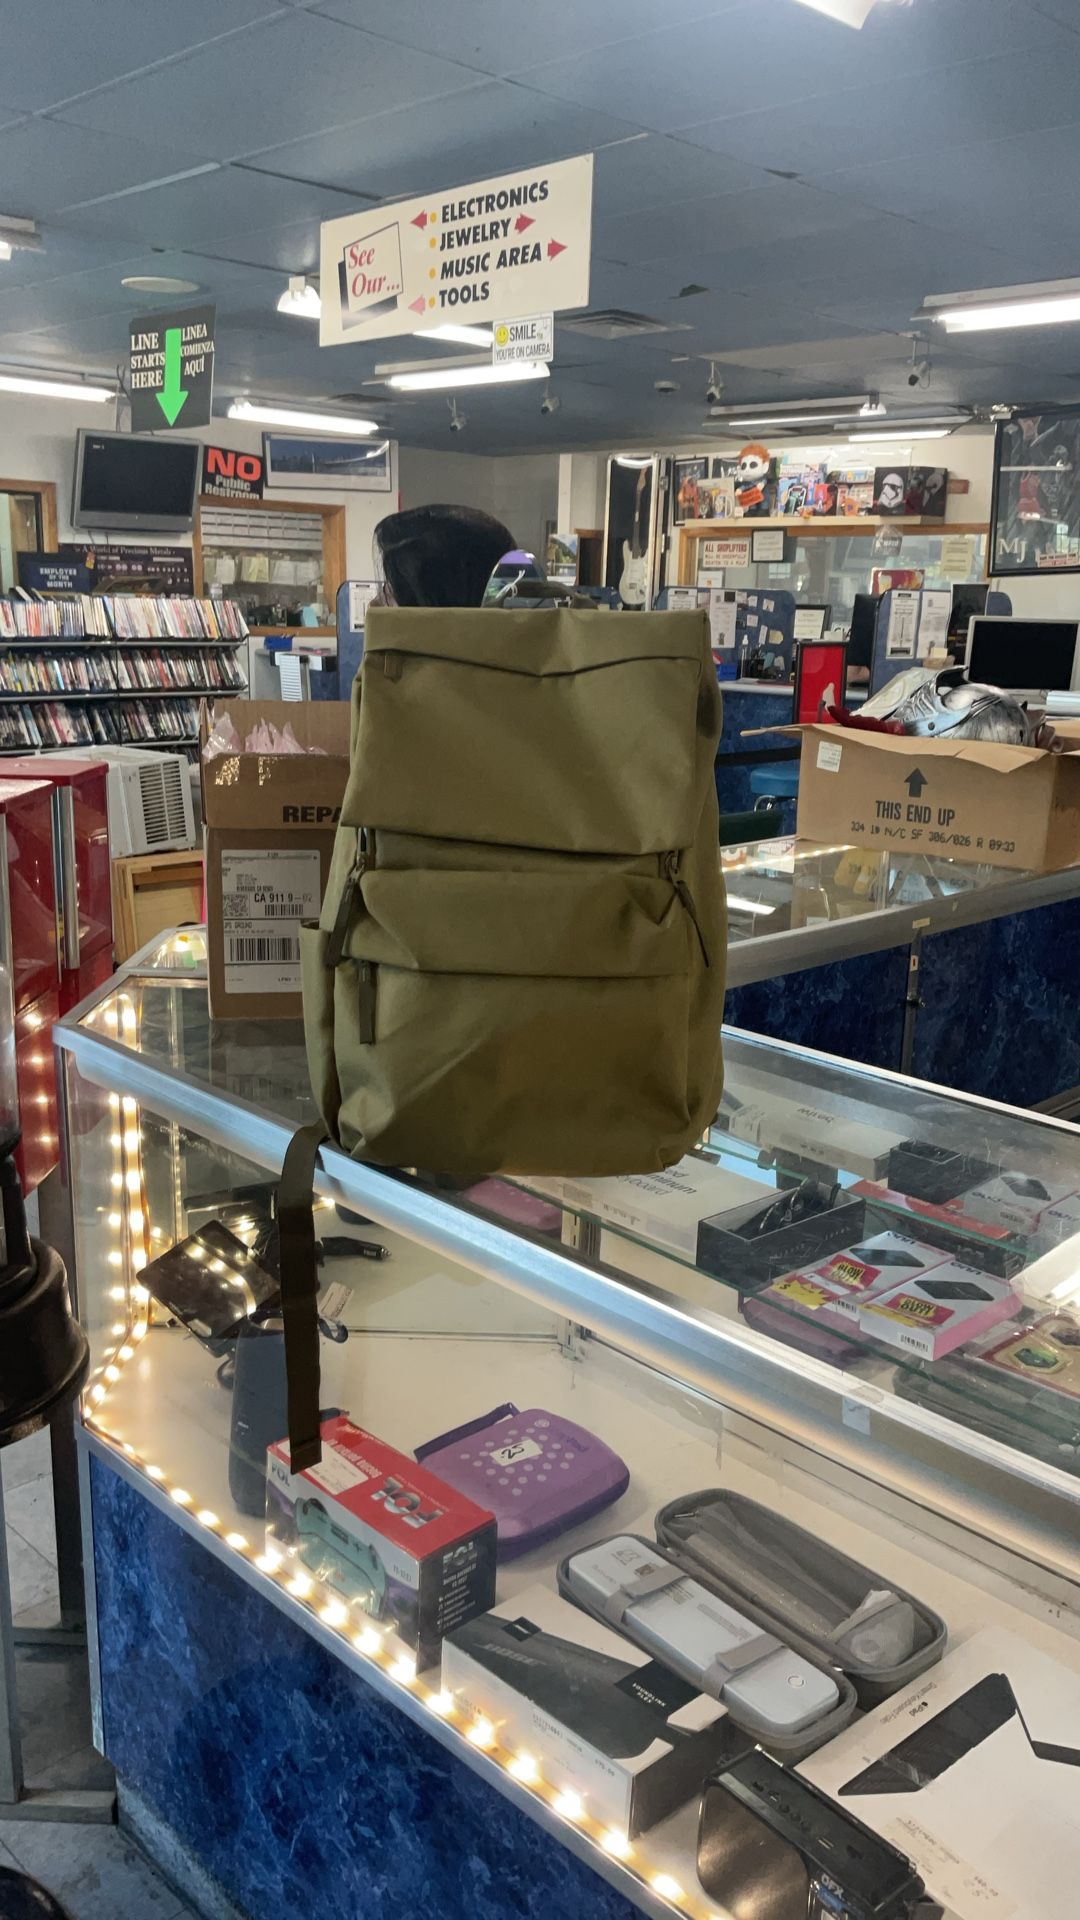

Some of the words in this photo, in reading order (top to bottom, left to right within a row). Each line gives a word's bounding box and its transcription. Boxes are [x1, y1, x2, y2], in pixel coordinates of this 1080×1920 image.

[442, 180, 549, 223] ELECTRONICS
[440, 218, 511, 251] JEWELRY
[348, 244, 375, 269] See
[440, 252, 490, 280] MUSIC
[496, 242, 542, 269] AREA
[439, 281, 490, 307] TOOLS
[131, 332, 159, 351] LINE
[182, 323, 207, 341] LINEA
[509, 323, 537, 342] SMILE
[180, 340, 215, 357] COMIENZA
[496, 346, 515, 360] YOU'RE
[516, 346, 525, 358] ON
[526, 343, 551, 357] CAMERA
[131, 352, 166, 369] STARTS
[131, 370, 163, 389] HERE
[208, 448, 261, 481] NO
[216, 475, 251, 491] Public
[1000, 537, 1027, 563] MJ
[876, 800, 902, 820] THIS
[906, 804, 932, 825] END
[938, 808, 955, 827] UP
[911, 828, 923, 840] SF
[976, 837, 983, 848] R
[254, 893, 266, 903] CA
[269, 893, 285, 903] 911
